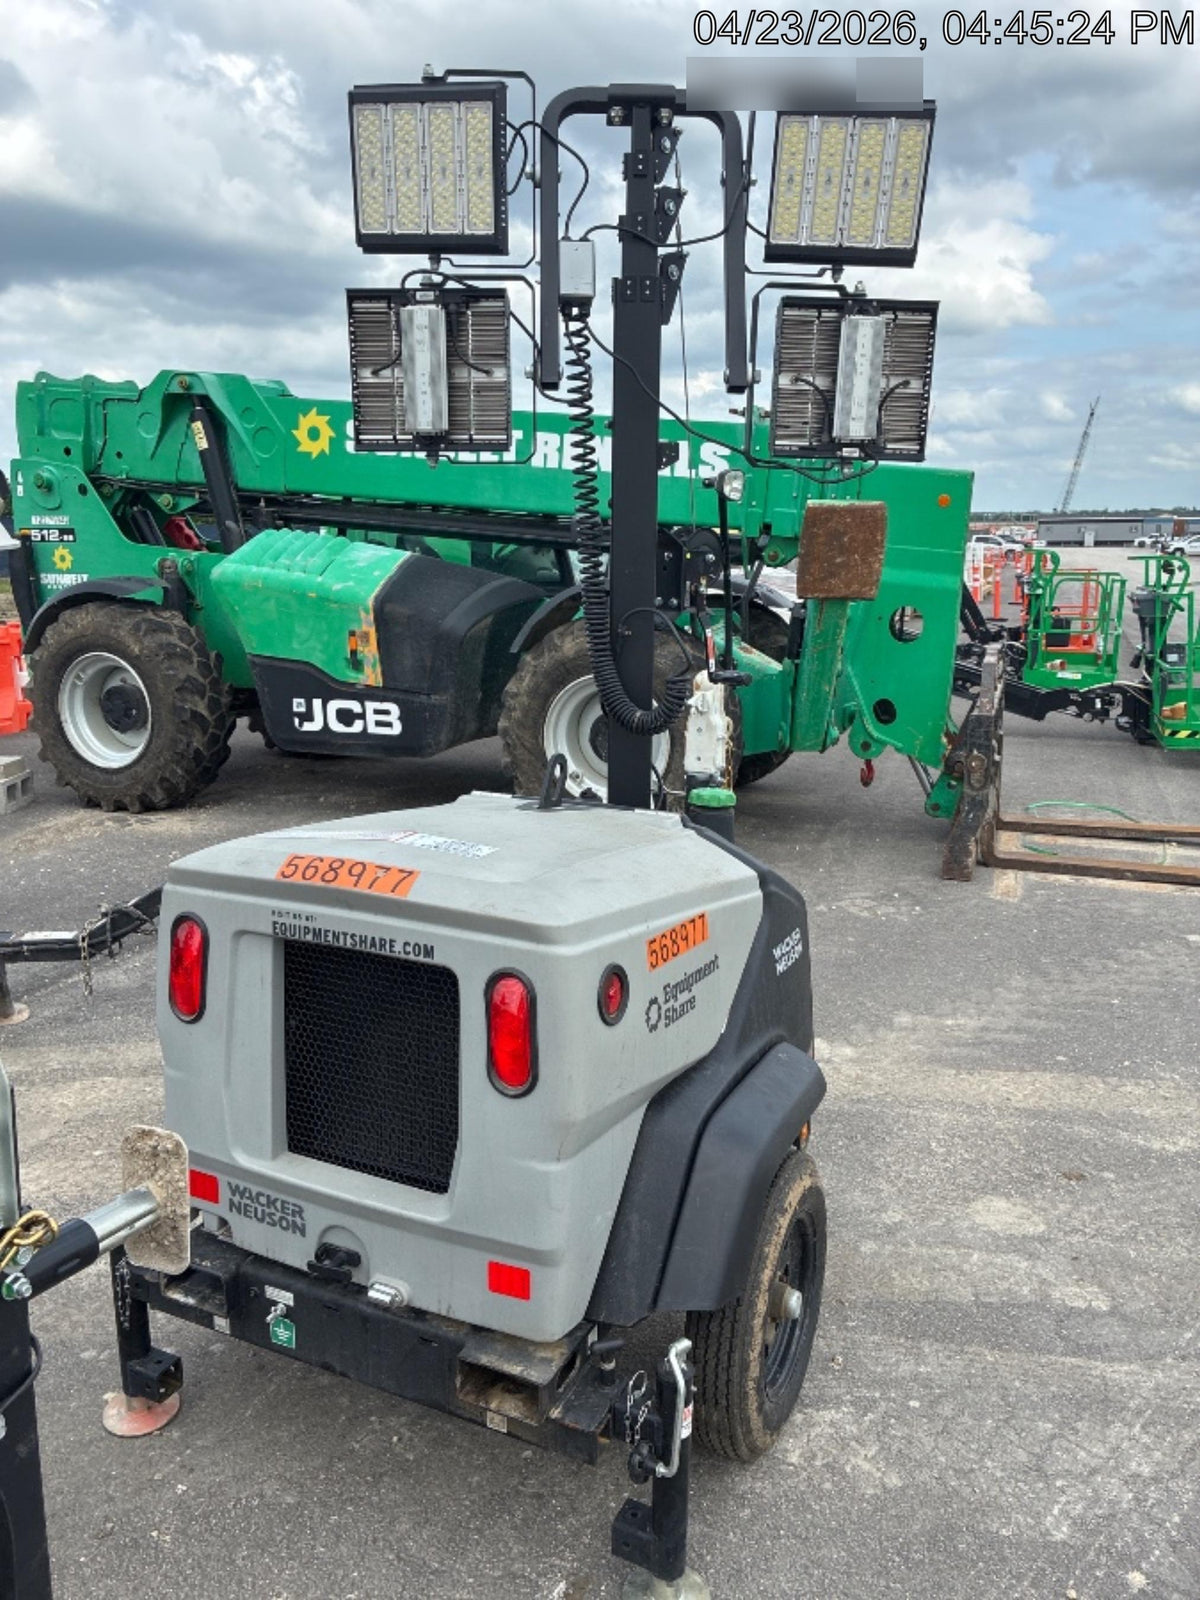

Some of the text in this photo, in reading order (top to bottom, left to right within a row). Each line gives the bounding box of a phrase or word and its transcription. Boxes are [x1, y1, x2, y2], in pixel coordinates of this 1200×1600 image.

[293, 698, 402, 735] JCB
[280, 855, 415, 894] 568977
[272, 920, 435, 960] EQUIPMENTSHARE.COM
[648, 913, 706, 969] 568977
[663, 953, 720, 1005] Equipment
[664, 995, 696, 1028] Share
[227, 1180, 306, 1222] WACKER
[228, 1197, 307, 1239] NEUSON
